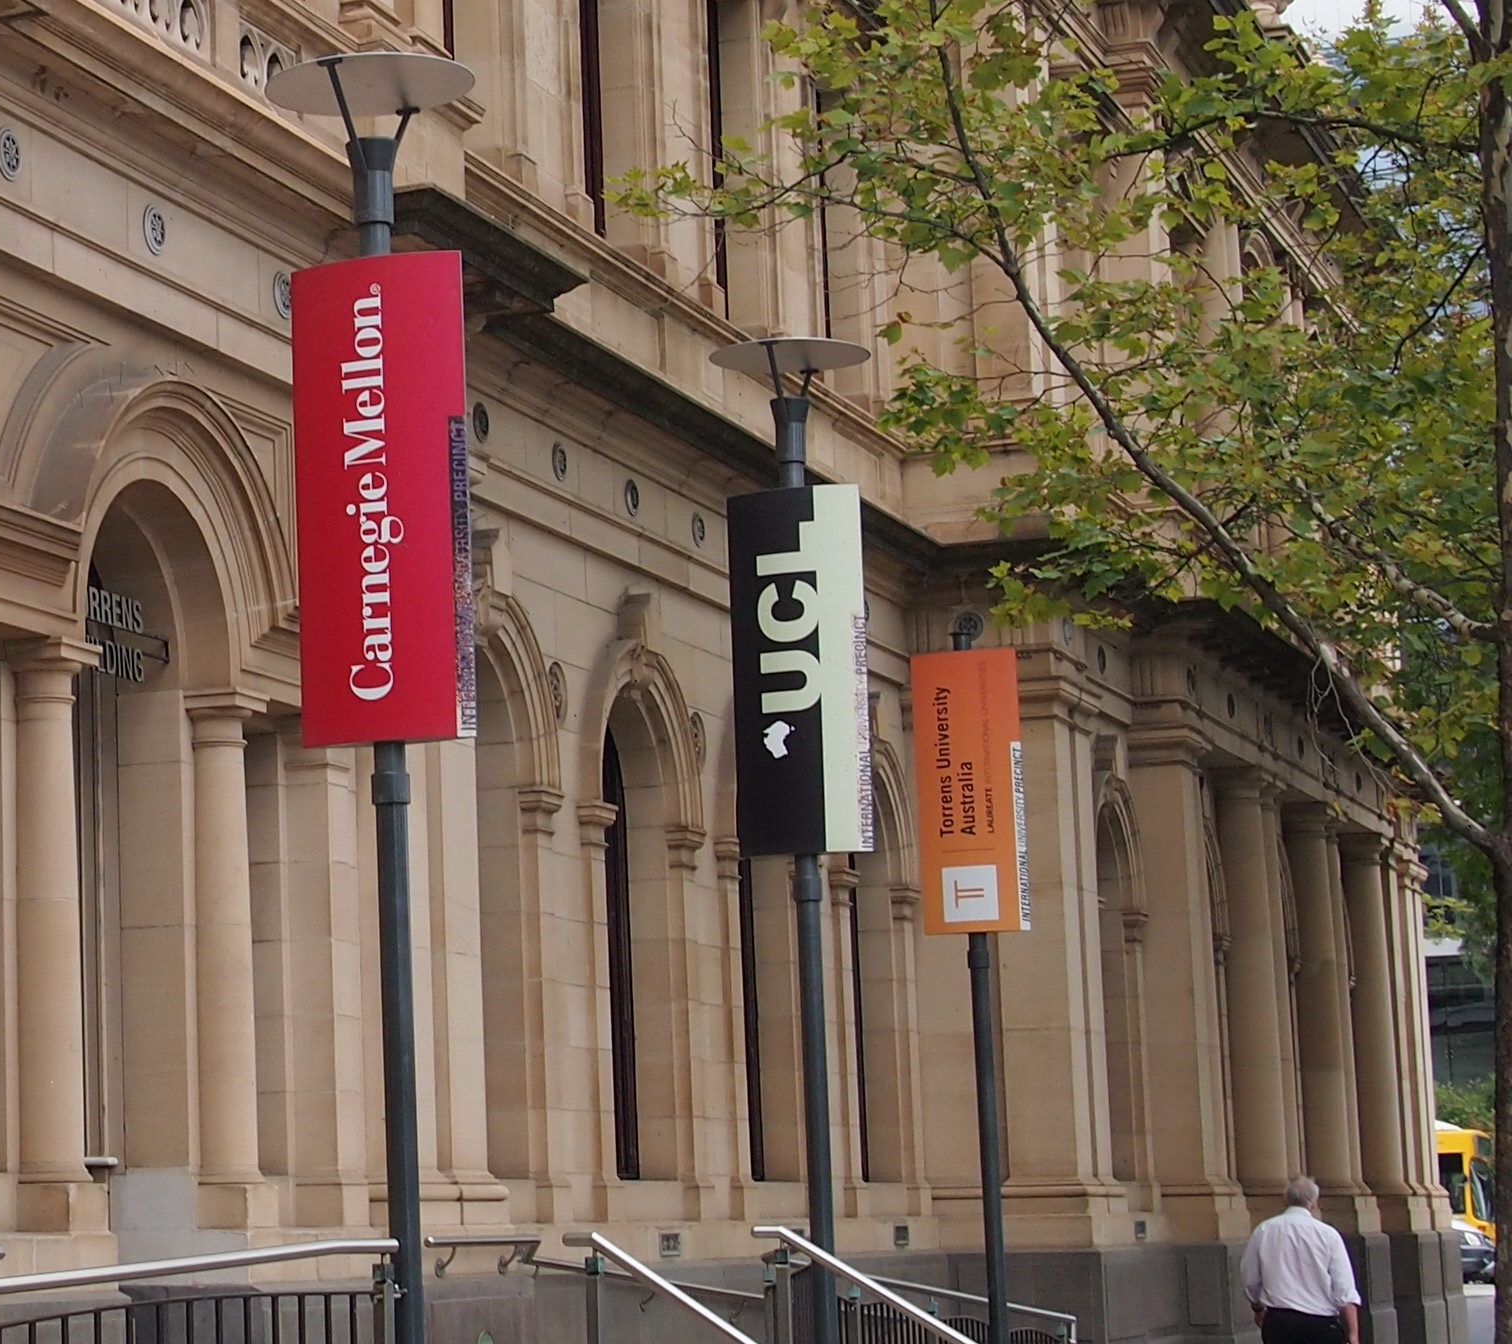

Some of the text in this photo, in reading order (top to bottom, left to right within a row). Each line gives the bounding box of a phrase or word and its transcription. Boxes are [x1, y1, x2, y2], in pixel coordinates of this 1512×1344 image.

[450, 420, 468, 501] PRECINCT
[87, 586, 145, 634] RRENS
[346, 472, 404, 701] Carnegie
[756, 521, 822, 713] UCL
[853, 615, 867, 675] PRECINCT
[859, 751, 873, 849] INTERNATIONAL
[933, 687, 954, 838] Torrens University
[957, 762, 976, 835] Australia
[985, 788, 994, 834] LAUREATE
[1012, 746, 1030, 922] INTERNATIONAL UNIVERSITY PRECINCT
